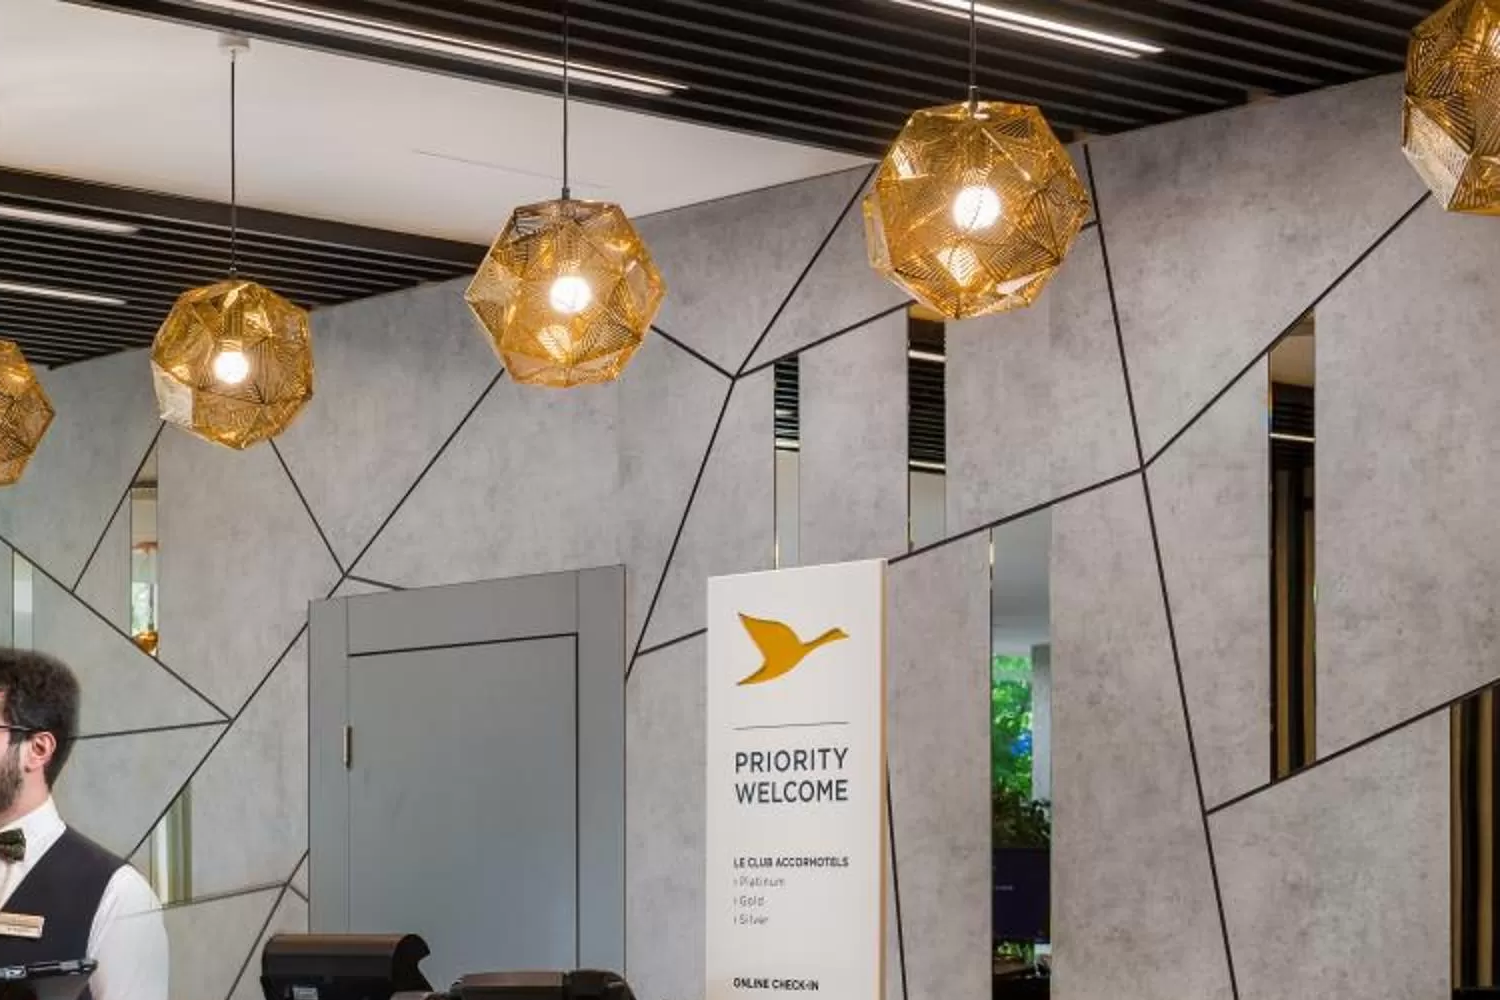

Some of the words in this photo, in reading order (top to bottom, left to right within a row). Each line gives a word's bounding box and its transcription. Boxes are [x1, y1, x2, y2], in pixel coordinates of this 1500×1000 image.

[735, 747, 849, 774] PRIORITY
[735, 779, 849, 804] WELCOME
[733, 856, 746, 868] LE
[747, 857, 773, 868] CLUB
[775, 856, 849, 868] ACCORHOTELS
[739, 875, 785, 888] Platinum
[739, 895, 765, 907] Gold
[739, 913, 769, 925] Silver
[733, 977, 770, 989] ONLINE
[771, 979, 819, 991] CHECK-IN
